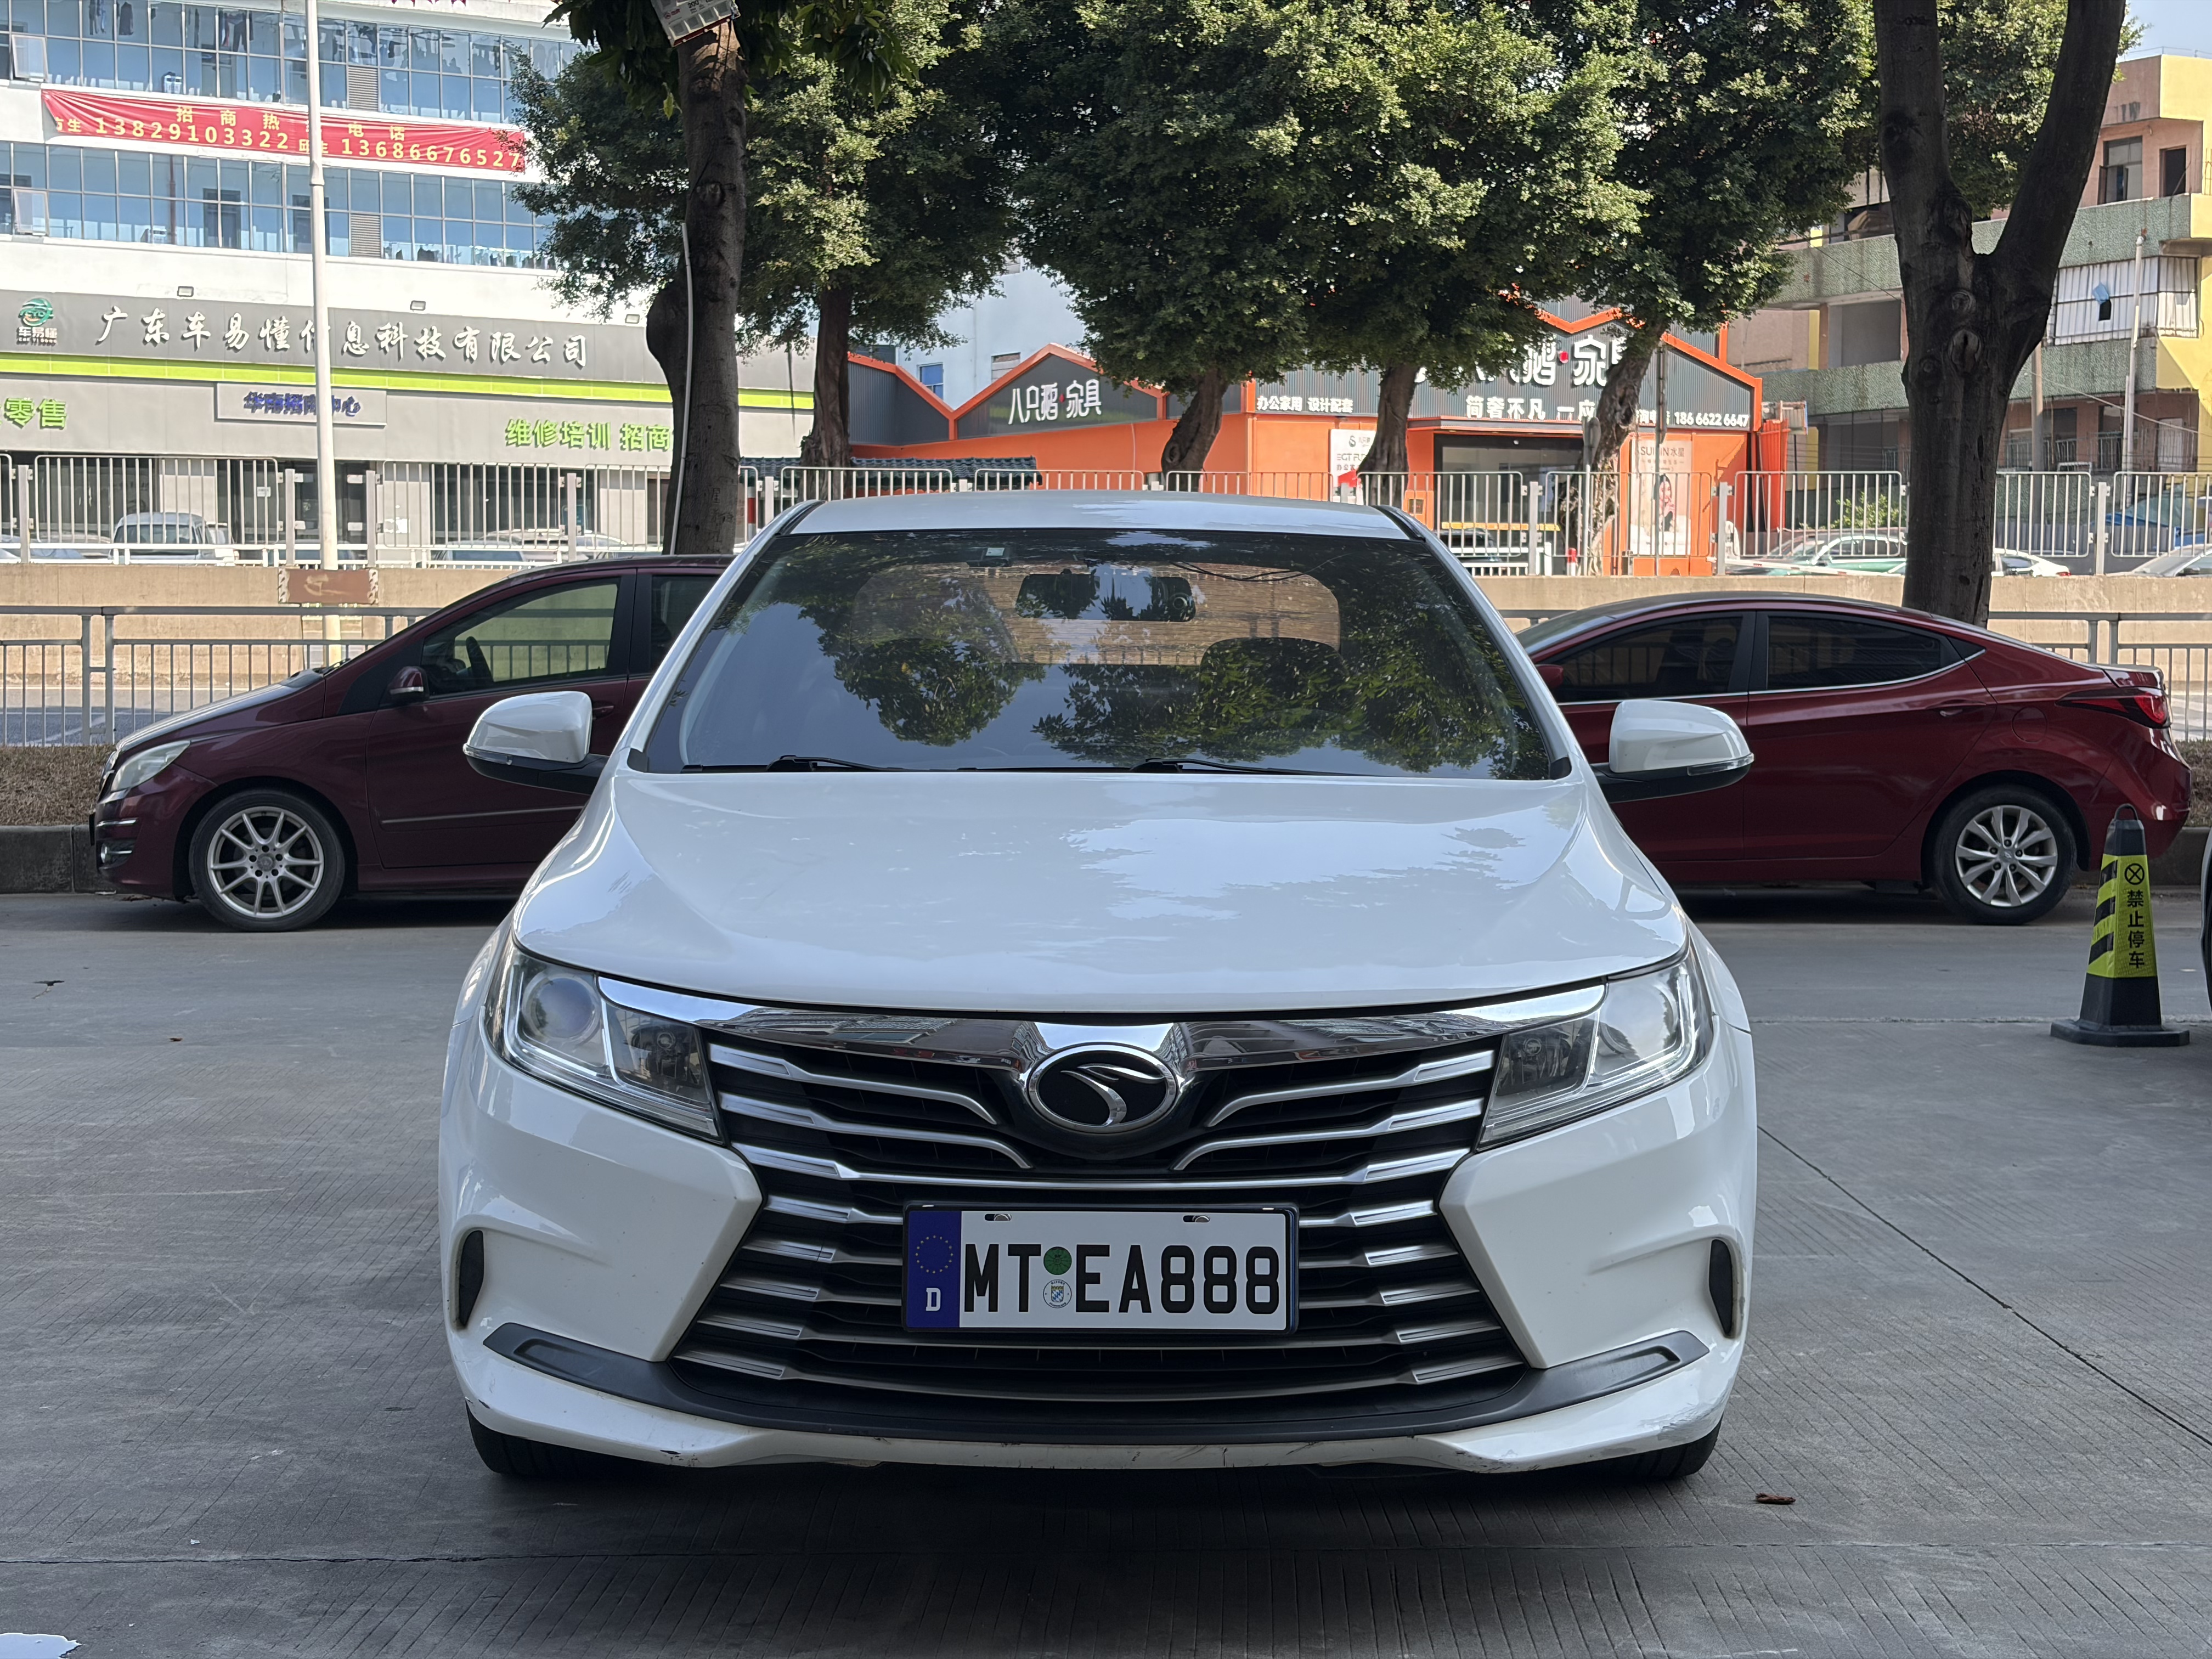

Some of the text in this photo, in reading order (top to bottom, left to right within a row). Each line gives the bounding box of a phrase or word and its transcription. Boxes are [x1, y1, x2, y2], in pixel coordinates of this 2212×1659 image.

[176, 106, 405, 141] 招商热电话
[95, 117, 288, 149] 13829103322
[342, 138, 519, 167] 13686676527
[0, 398, 67, 430] 零售
[1257, 396, 1353, 413] 办公家用 设计配套
[1466, 396, 1546, 420] 简奢不凡
[1674, 411, 1694, 425] 186
[1696, 413, 1722, 426] 6622
[1724, 414, 1750, 427] 6647
[505, 419, 673, 452] 维修培训 招商
[2127, 890, 2145, 969] 禁止停车
[964, 1244, 1279, 1314] MT EA888
[926, 1288, 941, 1312] D
